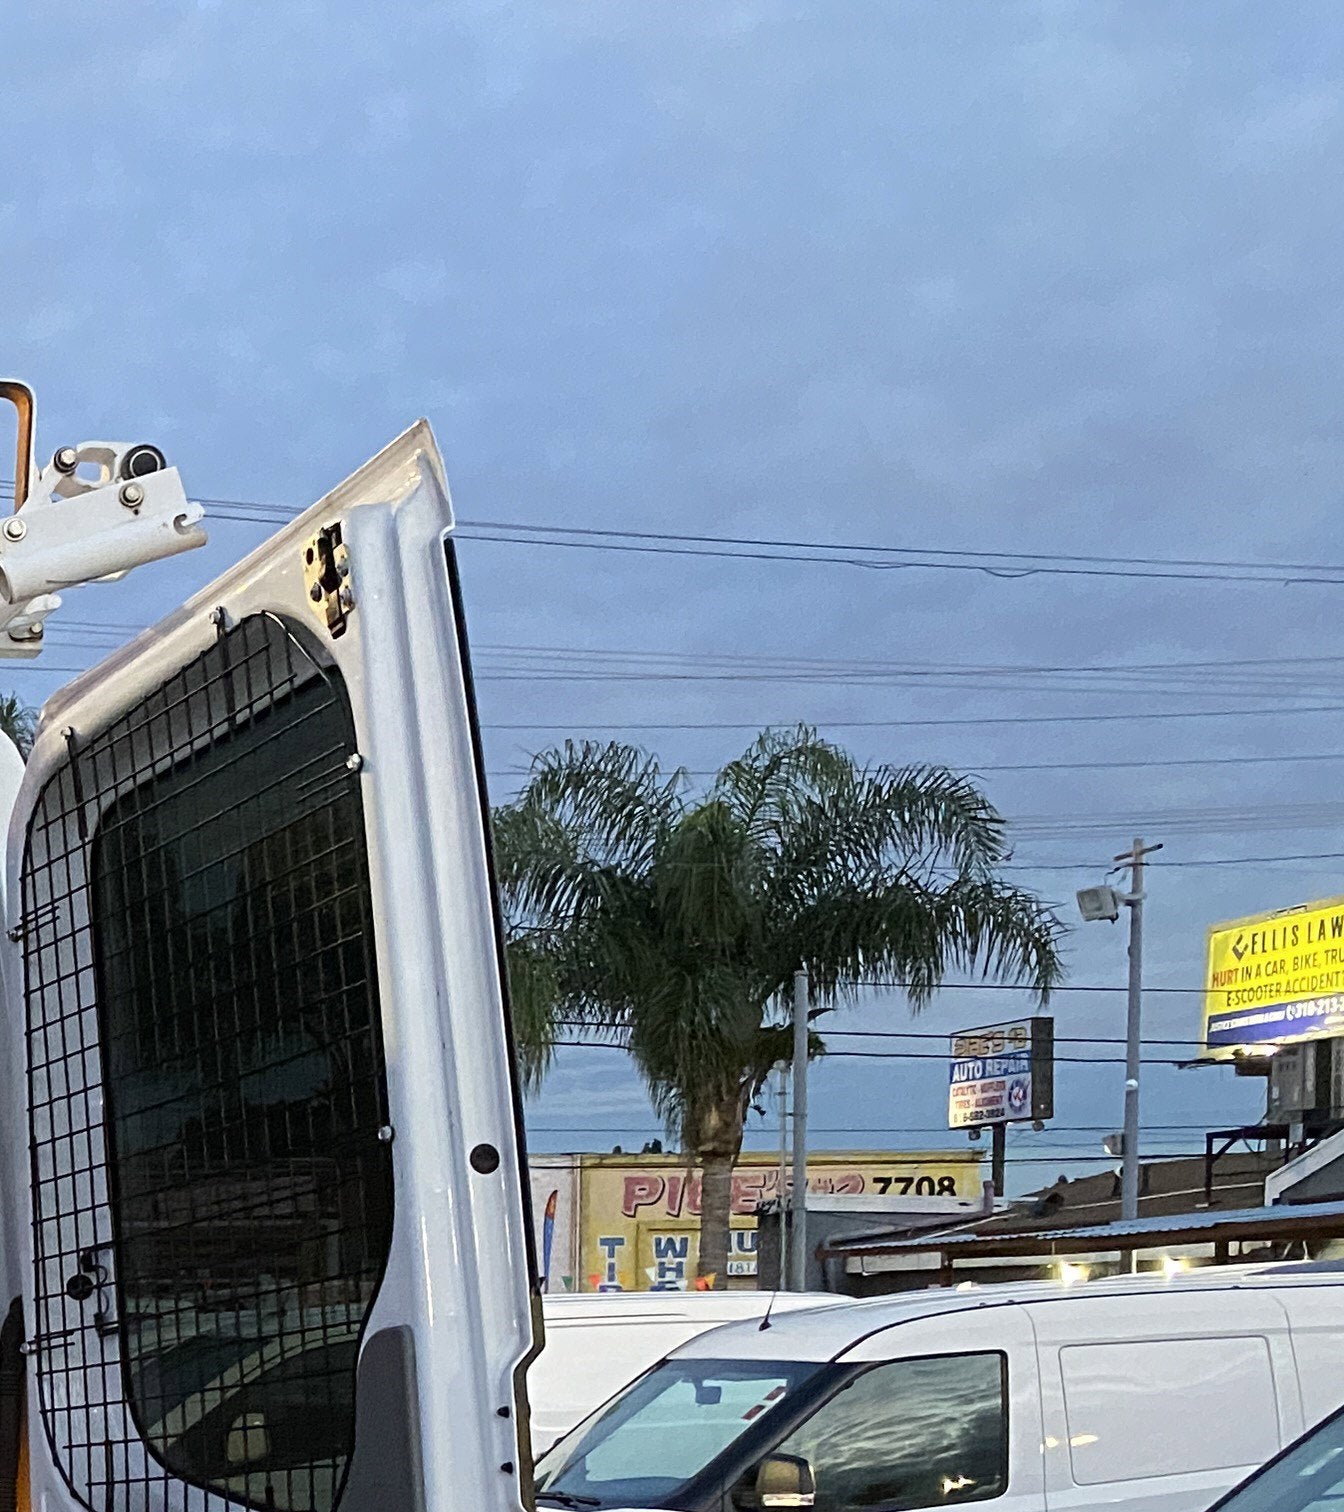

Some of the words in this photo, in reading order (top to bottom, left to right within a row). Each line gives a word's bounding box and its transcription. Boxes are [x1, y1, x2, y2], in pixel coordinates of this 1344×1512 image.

[1251, 925, 1299, 955] ELLIS
[1308, 915, 1344, 944] LAW
[1212, 967, 1239, 988] HURT
[1242, 964, 1253, 982] IN
[1255, 963, 1263, 980] A
[1265, 958, 1289, 978] CAR,
[1293, 952, 1321, 972] BIKE,
[1226, 982, 1282, 1007] E-SCOOTER
[1285, 970, 1344, 994] ACCIDENT
[952, 1059, 983, 1083] AUTO
[873, 1176, 957, 1197] 7708
